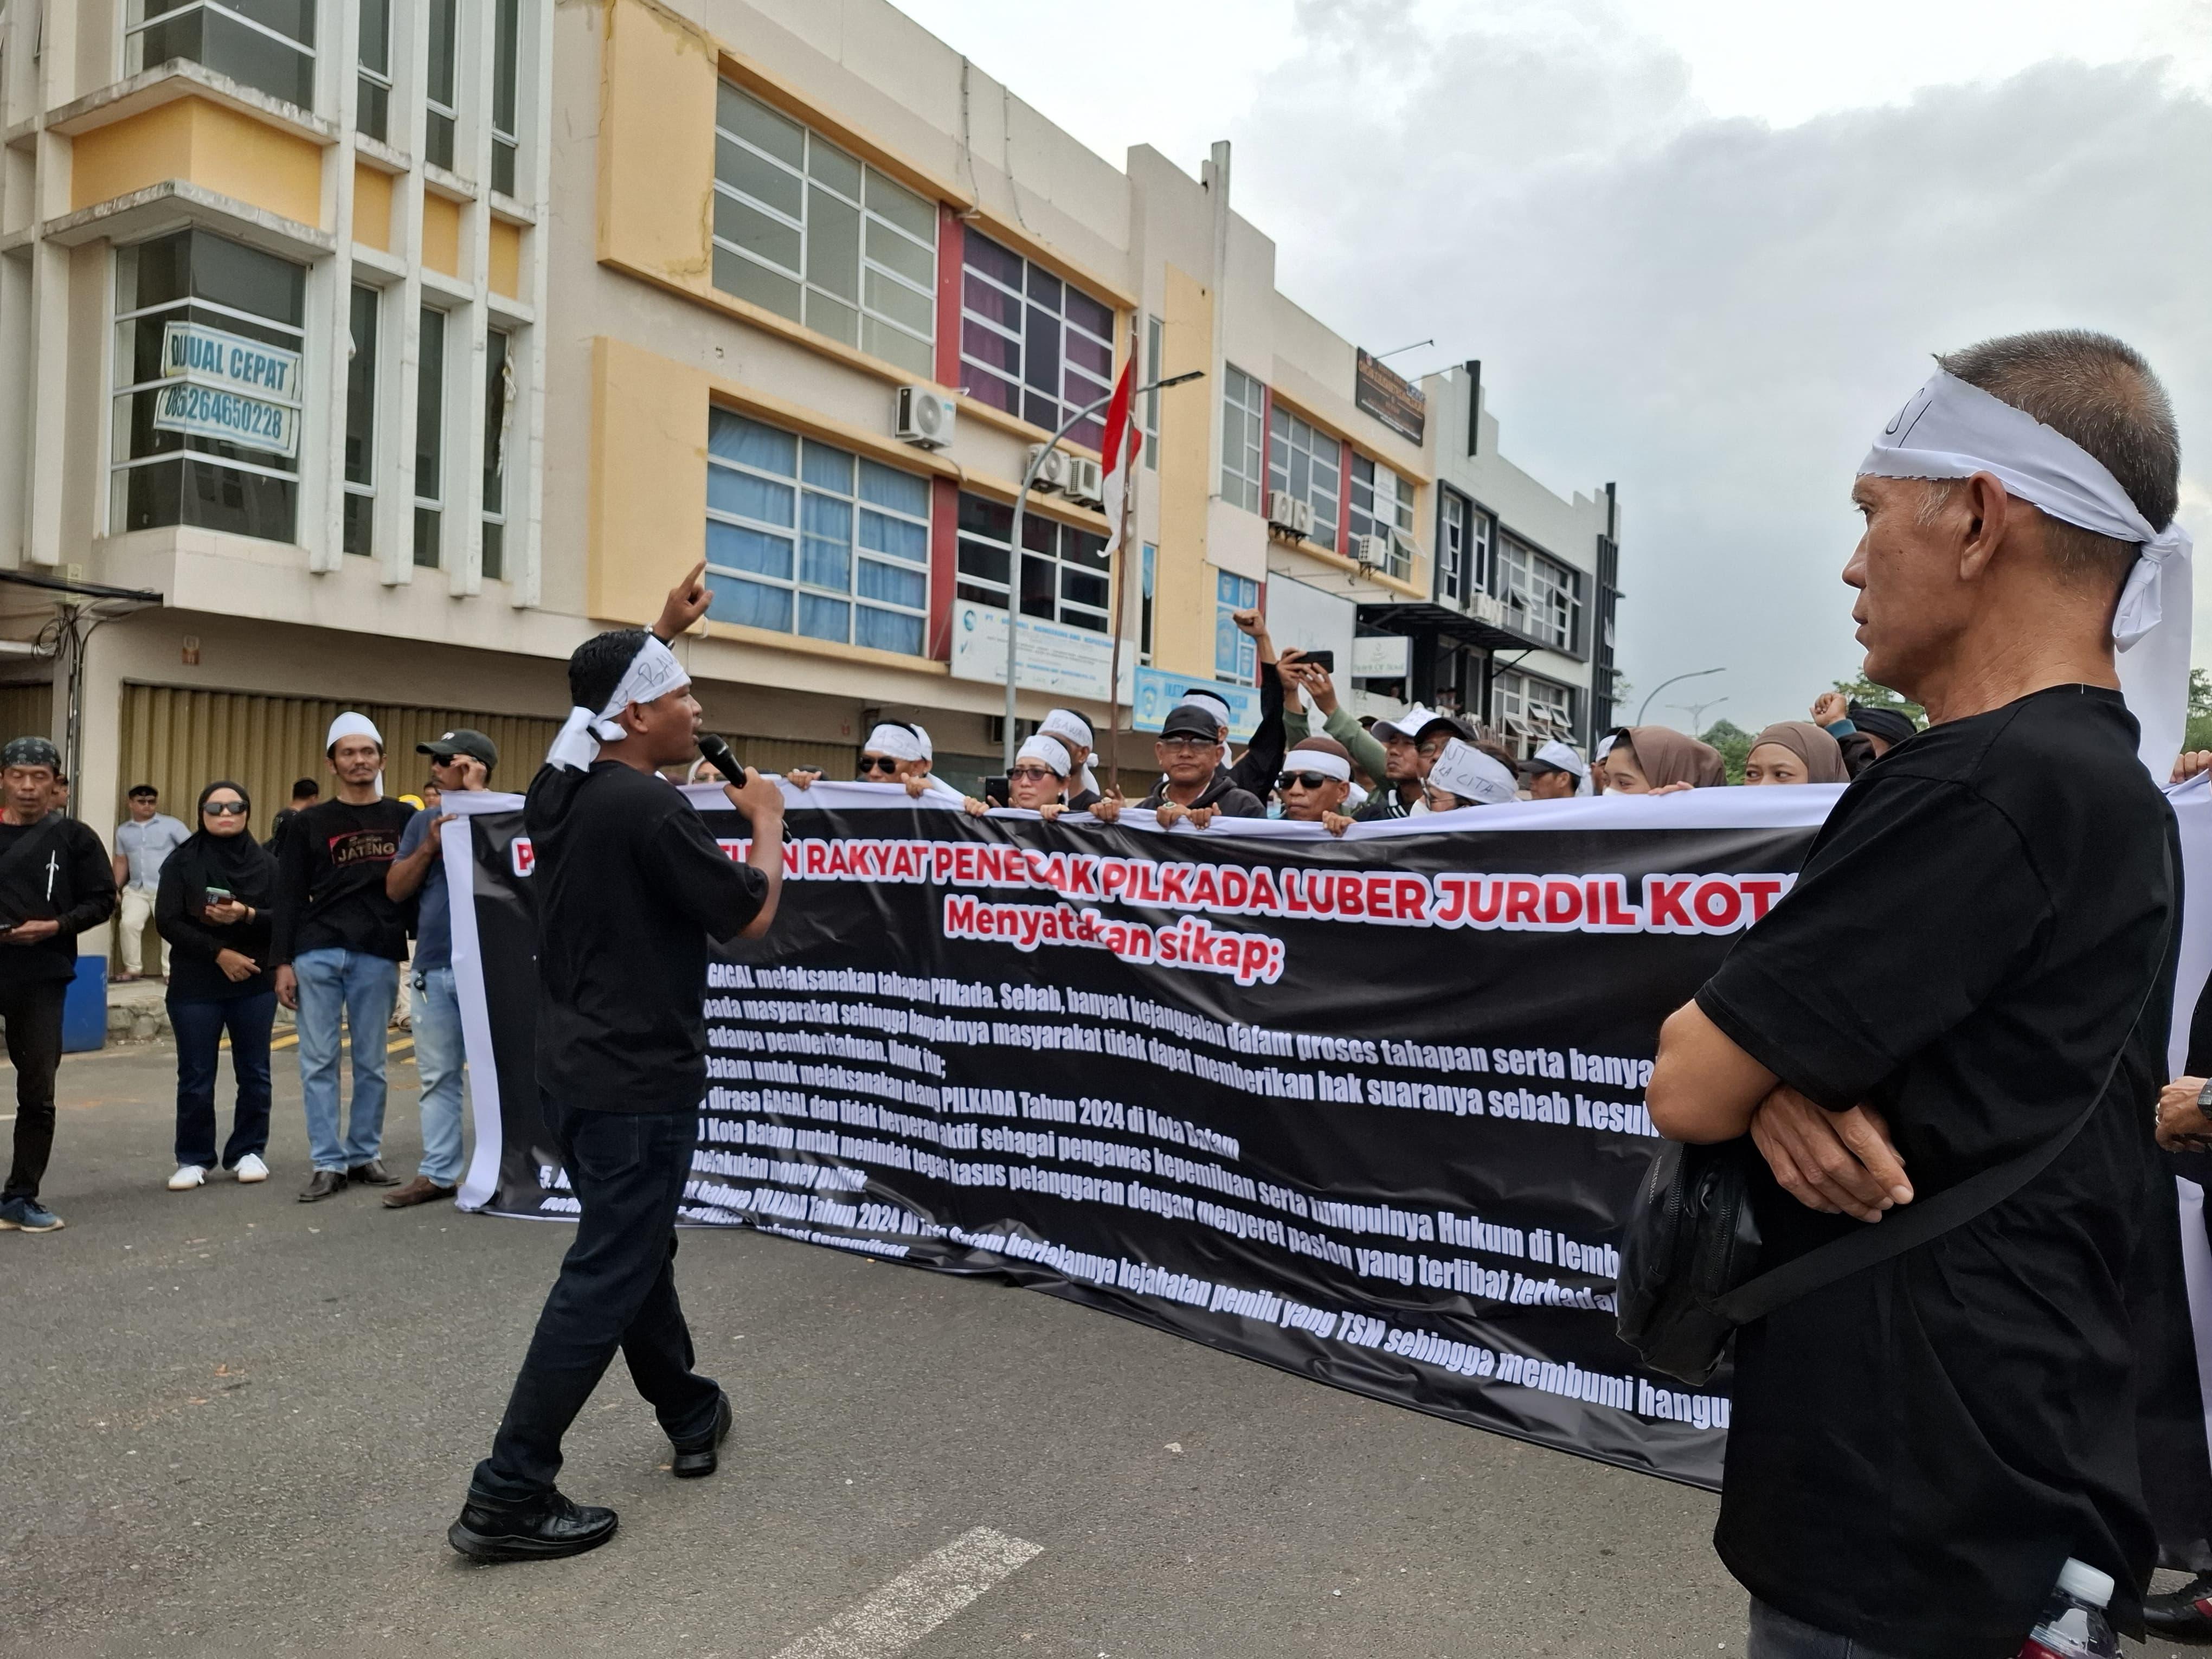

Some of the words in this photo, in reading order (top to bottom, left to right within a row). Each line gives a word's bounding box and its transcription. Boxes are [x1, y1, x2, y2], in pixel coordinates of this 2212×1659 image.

[230, 348, 288, 391] CEPAT
[1456, 773, 1494, 794] CITA
[807, 844, 929, 878] RAKYAT
[1102, 863, 1278, 911] PILKADA
[1283, 874, 1428, 921] LUBER
[1437, 879, 1637, 927] JURDIL
[1650, 879, 1785, 928] KOT
[1159, 921, 1280, 980] sikap;
[707, 962, 756, 989] GAGAL
[755, 966, 877, 994] melaksanakan
[877, 971, 930, 1001] tahapan
[931, 978, 999, 1008] Pilkada.
[1000, 982, 1066, 1015] Sebab,
[1066, 986, 1130, 1020] banyak
[1130, 995, 1227, 1048] kejanggalan
[1226, 1021, 1294, 1058] dalam
[1296, 1033, 1379, 1065] proses
[1380, 1039, 1489, 1072] tahapan
[1492, 1047, 1565, 1080] serta
[1570, 1047, 1659, 1090] banya
[707, 1025, 765, 1052] adanya
[764, 1030, 888, 1063] pemberitahuan.
[888, 1039, 923, 1072] Untuk
[742, 999, 840, 1024] masyarakat
[841, 1002, 908, 1034] sehingga
[909, 1008, 990, 1046] banyaknya
[992, 1023, 1103, 1053] masyarakat
[1103, 1028, 1148, 1062] tidak
[1148, 1037, 1194, 1075] dapat
[1194, 1053, 1315, 1101] memberikan
[1317, 1070, 1364, 1104] hak
[1367, 1078, 1484, 1116] suaranya
[1488, 1088, 1571, 1126] sebab
[753, 1060, 800, 1084] untuk
[799, 1063, 903, 1102] melaksanakan
[903, 1079, 941, 1113] ulang
[941, 1086, 1018, 1117] PILKADA
[1019, 1091, 1077, 1123] Tahun
[1079, 1097, 1125, 1130] 2024
[1127, 1105, 1146, 1134] di
[1146, 1108, 1186, 1144] Kota
[708, 1086, 761, 1111] dirasa
[762, 1088, 809, 1117] GAGAL
[809, 1094, 838, 1122] dan
[839, 1098, 878, 1129] tidak
[878, 1104, 940, 1143] berperan
[940, 1122, 978, 1149] aktif
[981, 1126, 1056, 1159] sebagai
[1057, 1135, 1152, 1173] pengawas
[1153, 1147, 1257, 1202] kepemiluan
[1257, 1180, 1308, 1218] serta
[1308, 1195, 1435, 1242] tumpulnya
[1437, 1211, 1524, 1258] Hukum
[1528, 1227, 1553, 1264] di
[1557, 1232, 1620, 1280] lemb
[708, 1117, 744, 1143] Kota
[745, 1120, 794, 1149] Batam
[795, 1129, 839, 1156] untuk
[840, 1137, 912, 1171] menindak
[912, 1147, 950, 1180] tegas
[950, 1158, 1007, 1187] kasus
[1008, 1165, 1124, 1206] pelanggaran
[1127, 1181, 1195, 1221] dengan
[1196, 1200, 1287, 1247] menyeret
[1287, 1226, 1353, 1271] paslon
[1355, 1248, 1414, 1287] yang
[1417, 1254, 1510, 1301] terlibat
[769, 1159, 819, 1189] money
[808, 1195, 857, 1228] Tahun
[857, 1202, 901, 1233] 2024
[1005, 1232, 1117, 1284] berjalannya
[1117, 1257, 1212, 1307] kejahatan
[1208, 1284, 1283, 1323] pemilu
[1279, 1301, 1338, 1338] yang
[1336, 1310, 1386, 1348] TSM
[1383, 1328, 1495, 1377] sehingga
[1496, 1352, 1634, 1412] membumi
[1638, 1378, 1731, 1430] hangu
